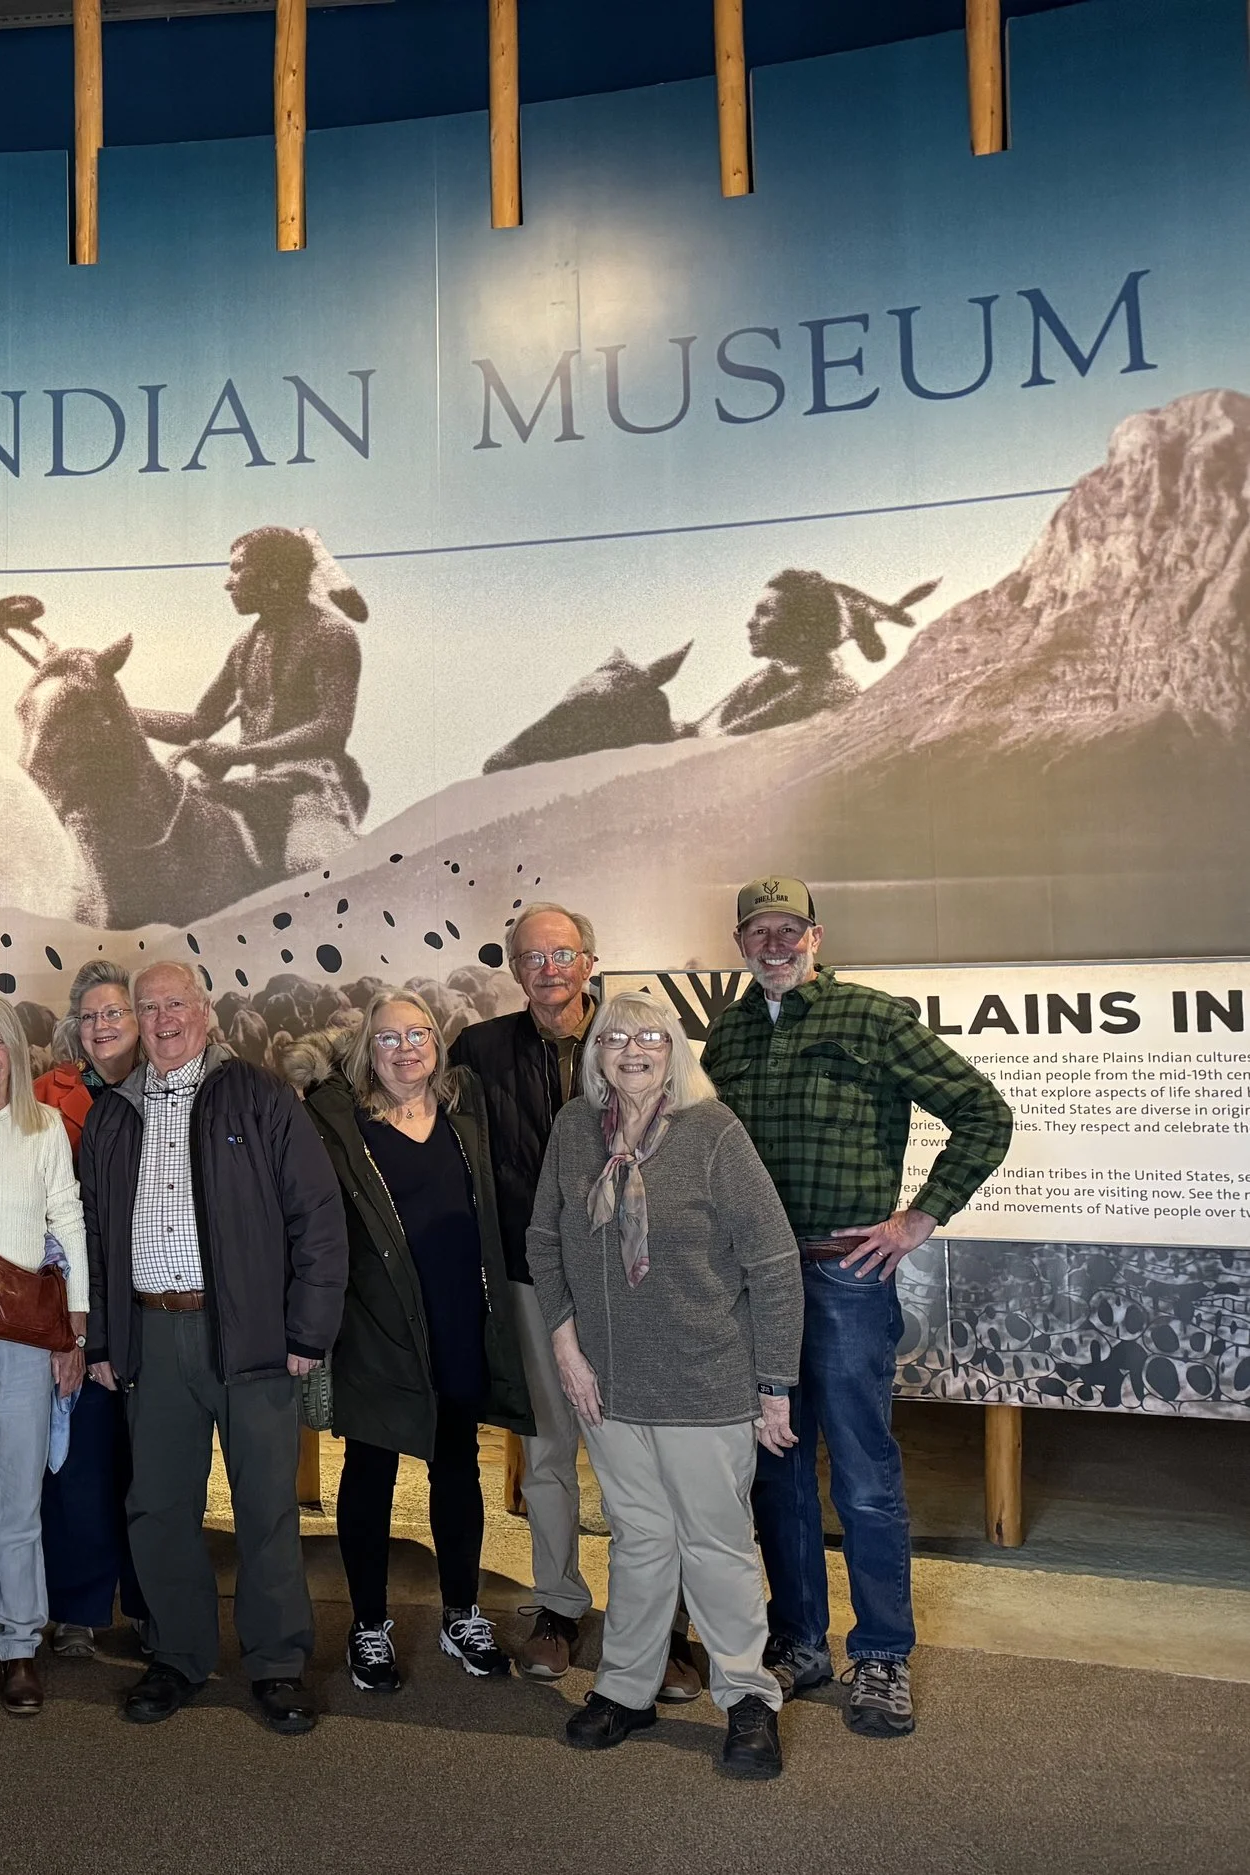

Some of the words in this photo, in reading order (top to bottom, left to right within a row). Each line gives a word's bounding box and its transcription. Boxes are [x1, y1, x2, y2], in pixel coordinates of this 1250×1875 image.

[472, 268, 1159, 450] MUSEUM
[900, 991, 1141, 1035] LAINS
[966, 1053, 1029, 1066] xperience
[1033, 1052, 1057, 1063] and
[1062, 1052, 1098, 1063] share
[1103, 1052, 1143, 1063] Plains
[1148, 1052, 1191, 1062] Indian
[1000, 1070, 1041, 1080] Indian
[1046, 1070, 1091, 1083] people
[1095, 1069, 1127, 1080] from
[1132, 1069, 1155, 1080] the
[1160, 1069, 1222, 1080] mid-19th
[1010, 1086, 1037, 1097] that
[1041, 1087, 1091, 1100] explore
[1095, 1088, 1146, 1100] aspects
[1151, 1086, 1165, 1097] of
[1169, 1086, 1190, 1097] life
[1195, 1086, 1242, 1097] shared
[1021, 1104, 1065, 1114] United
[1070, 1104, 1111, 1114] States
[1141, 1104, 1190, 1115] diverse
[1195, 1104, 1207, 1115] in
[910, 1120, 945, 1132] ories,
[1014, 1121, 1041, 1131] ties.
[1044, 1121, 1076, 1135] They
[1081, 1122, 1130, 1135] respect
[1134, 1121, 1159, 1132] and
[1164, 1121, 1229, 1133] celebrate
[1233, 1122, 1250, 1133] th
[907, 1166, 928, 1176] the
[1003, 1167, 1044, 1178] Indian
[1049, 1168, 1087, 1179] tribes
[1091, 1169, 1103, 1179] in
[1107, 1169, 1130, 1180] the
[1135, 1170, 1181, 1181] United
[1186, 1171, 1233, 1184] States,
[976, 1184, 1011, 1197] egion
[1015, 1184, 1042, 1195] that
[1046, 1188, 1069, 1199] you
[1074, 1188, 1094, 1196] are
[1098, 1186, 1148, 1201] visiting
[1152, 1190, 1185, 1198] now.
[1189, 1188, 1213, 1199] See
[1216, 1189, 1240, 1200] the
[975, 1201, 999, 1211] and
[1004, 1203, 1083, 1213] movements
[1087, 1203, 1101, 1214] of
[1105, 1204, 1149, 1215] Native
[1154, 1205, 1201, 1220] people
[1205, 1209, 1236, 1217] over
